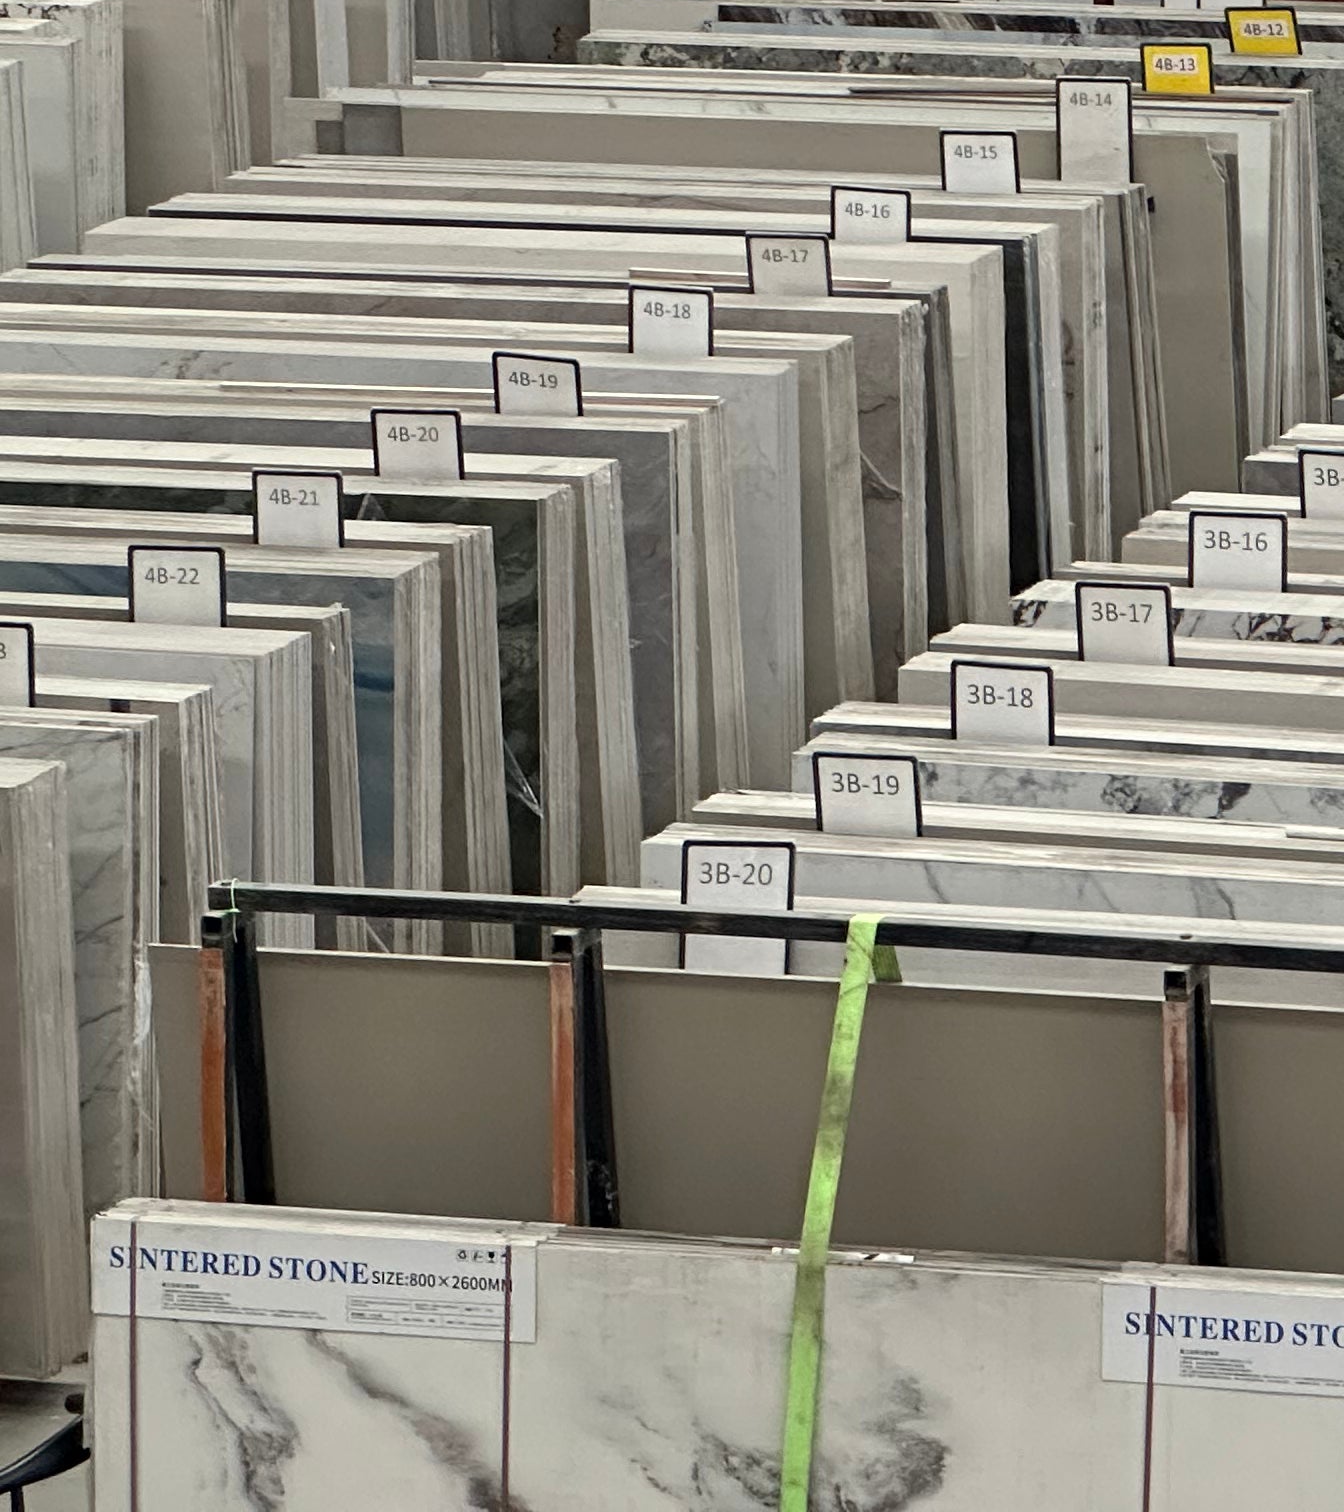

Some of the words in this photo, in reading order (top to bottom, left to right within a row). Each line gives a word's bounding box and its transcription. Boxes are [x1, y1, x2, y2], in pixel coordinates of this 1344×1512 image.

[1244, 24, 1283, 36] 4B-12
[1155, 58, 1195, 71] 4B-13
[1070, 93, 1112, 106] 4B-14
[954, 145, 997, 159] 4B-15
[845, 203, 890, 218] 4B-16
[762, 249, 808, 262] 4B-17
[644, 302, 690, 319] 4B-18
[509, 372, 557, 388] 4B-19
[388, 427, 438, 442] 4B-20
[269, 489, 319, 505] 4B-21
[1205, 530, 1267, 551] 3B-16
[145, 567, 199, 584] 4B-22
[1092, 602, 1152, 623] 3B-17
[968, 684, 1033, 708] 3B-18
[832, 773, 899, 795] 3B-19
[700, 862, 772, 885] 3B-20
[269, 1257, 368, 1284] STONE
